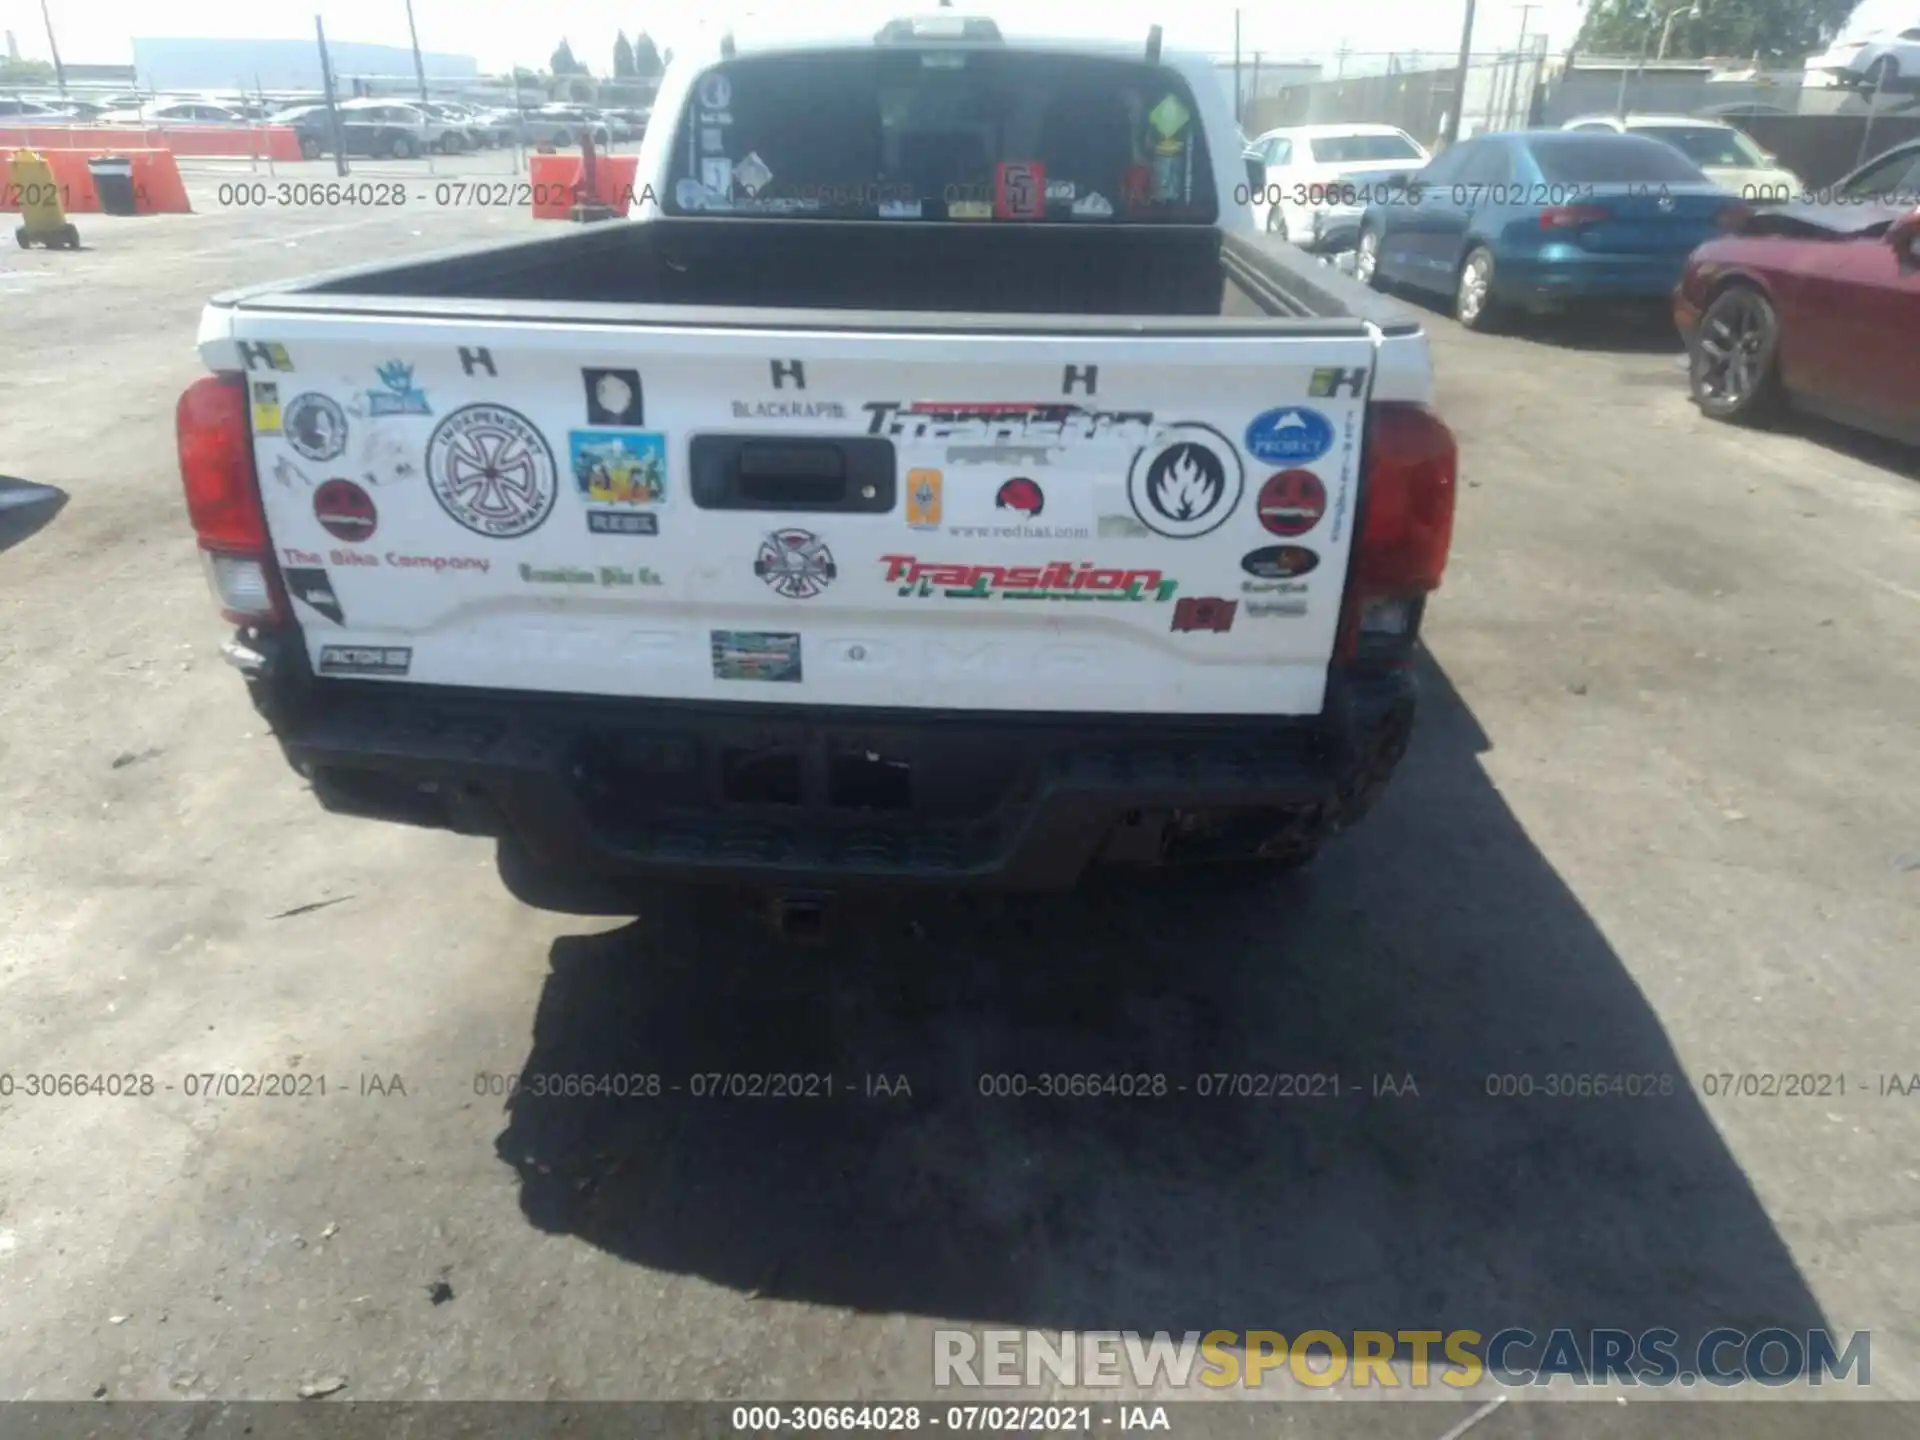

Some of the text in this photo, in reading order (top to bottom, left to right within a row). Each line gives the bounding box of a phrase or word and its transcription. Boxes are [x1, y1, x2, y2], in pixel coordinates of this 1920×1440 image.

[439, 411, 544, 456] INDEPENDENT
[438, 480, 480, 526] TRUCK
[484, 488, 547, 534] COMPANY
[949, 525, 1090, 539] www.redhat.com
[283, 548, 491, 574] The Bike Company
[879, 554, 1170, 598] Transition
